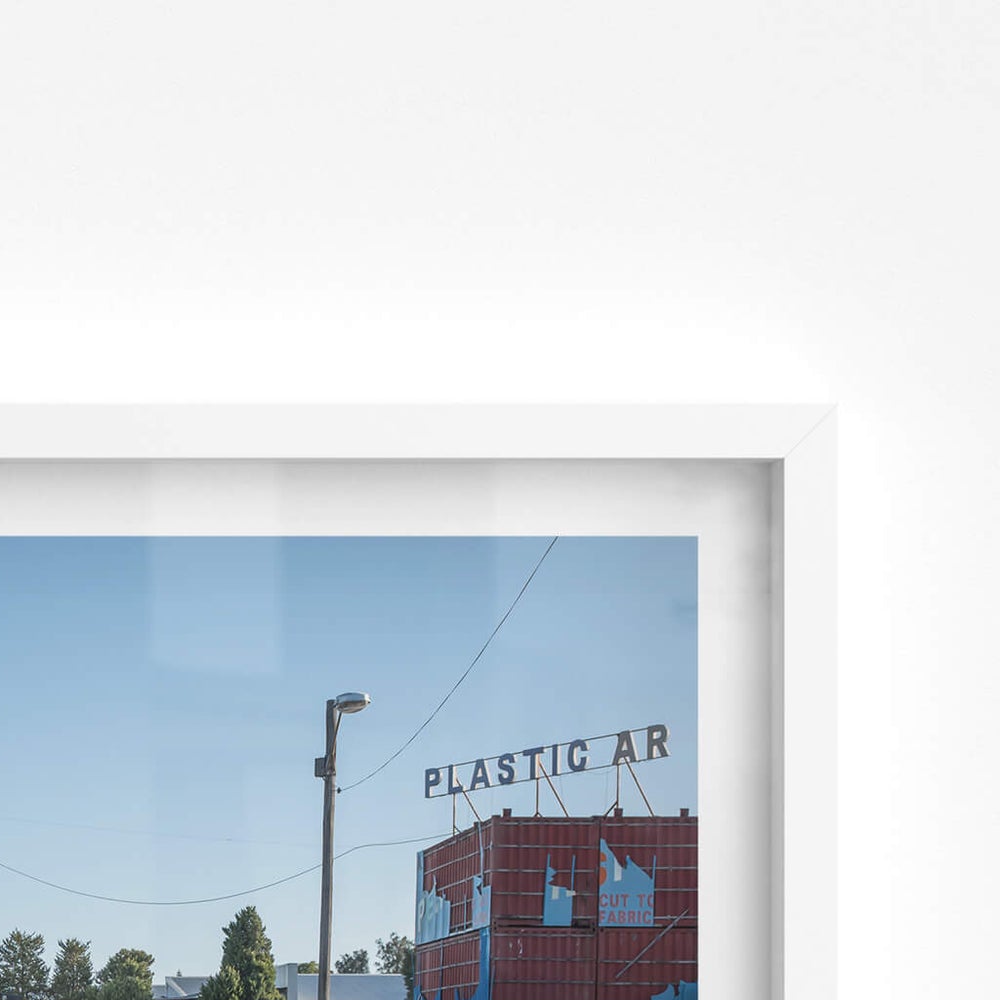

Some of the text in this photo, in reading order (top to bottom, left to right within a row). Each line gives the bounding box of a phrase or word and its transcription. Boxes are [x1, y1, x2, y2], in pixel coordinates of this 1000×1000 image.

[425, 724, 671, 798] PLASTIC AR
[600, 893, 629, 908] CUT
[600, 910, 652, 924] FABRIC
